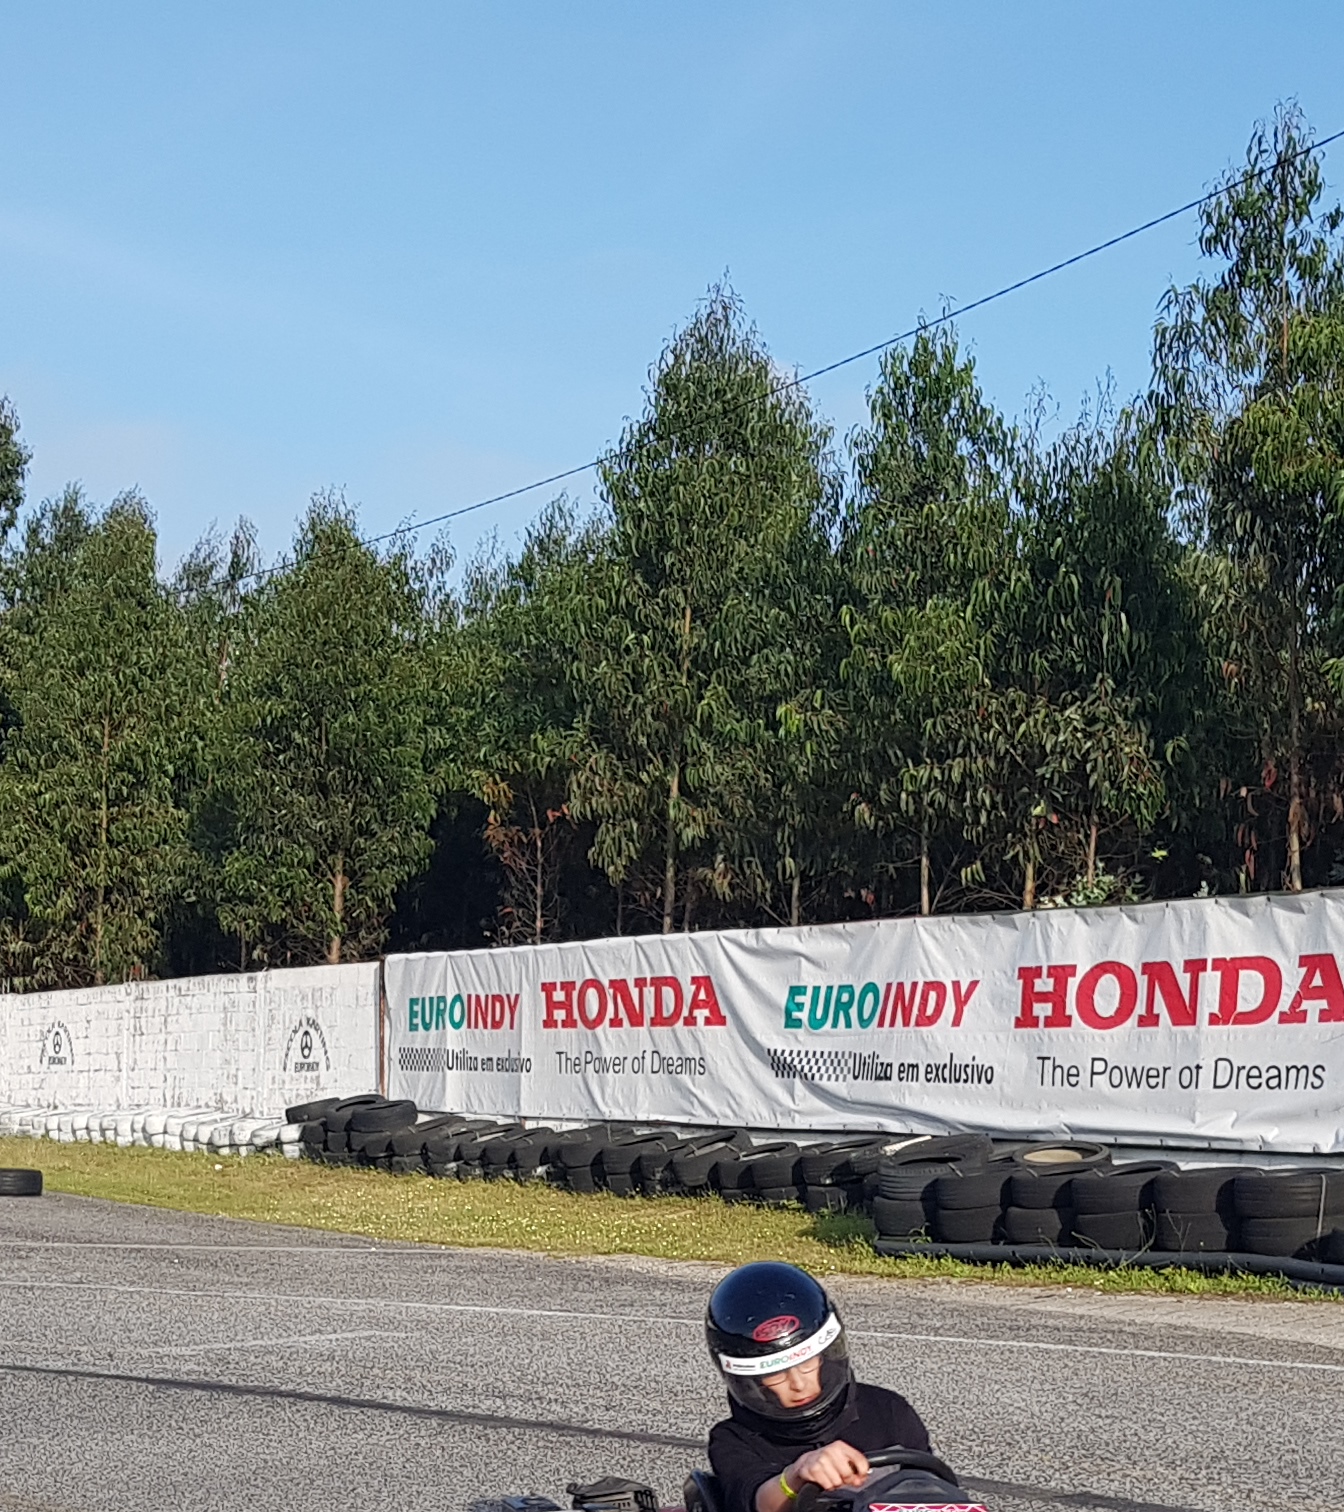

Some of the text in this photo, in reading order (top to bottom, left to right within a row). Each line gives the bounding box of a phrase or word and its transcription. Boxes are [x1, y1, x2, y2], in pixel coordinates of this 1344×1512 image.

[408, 992, 520, 1032] EUROINDY
[540, 975, 727, 1030] HONDA
[783, 979, 980, 1031] EUROINDY
[446, 1048, 478, 1071] Utiliza
[481, 1056, 494, 1072] em
[555, 1050, 706, 1076] The Power of Dreams
[852, 1052, 995, 1085] Utiliza em exclusivo
[1036, 1055, 1327, 1091] The Power of Dreams
[759, 1345, 813, 1369] EUROINDY
